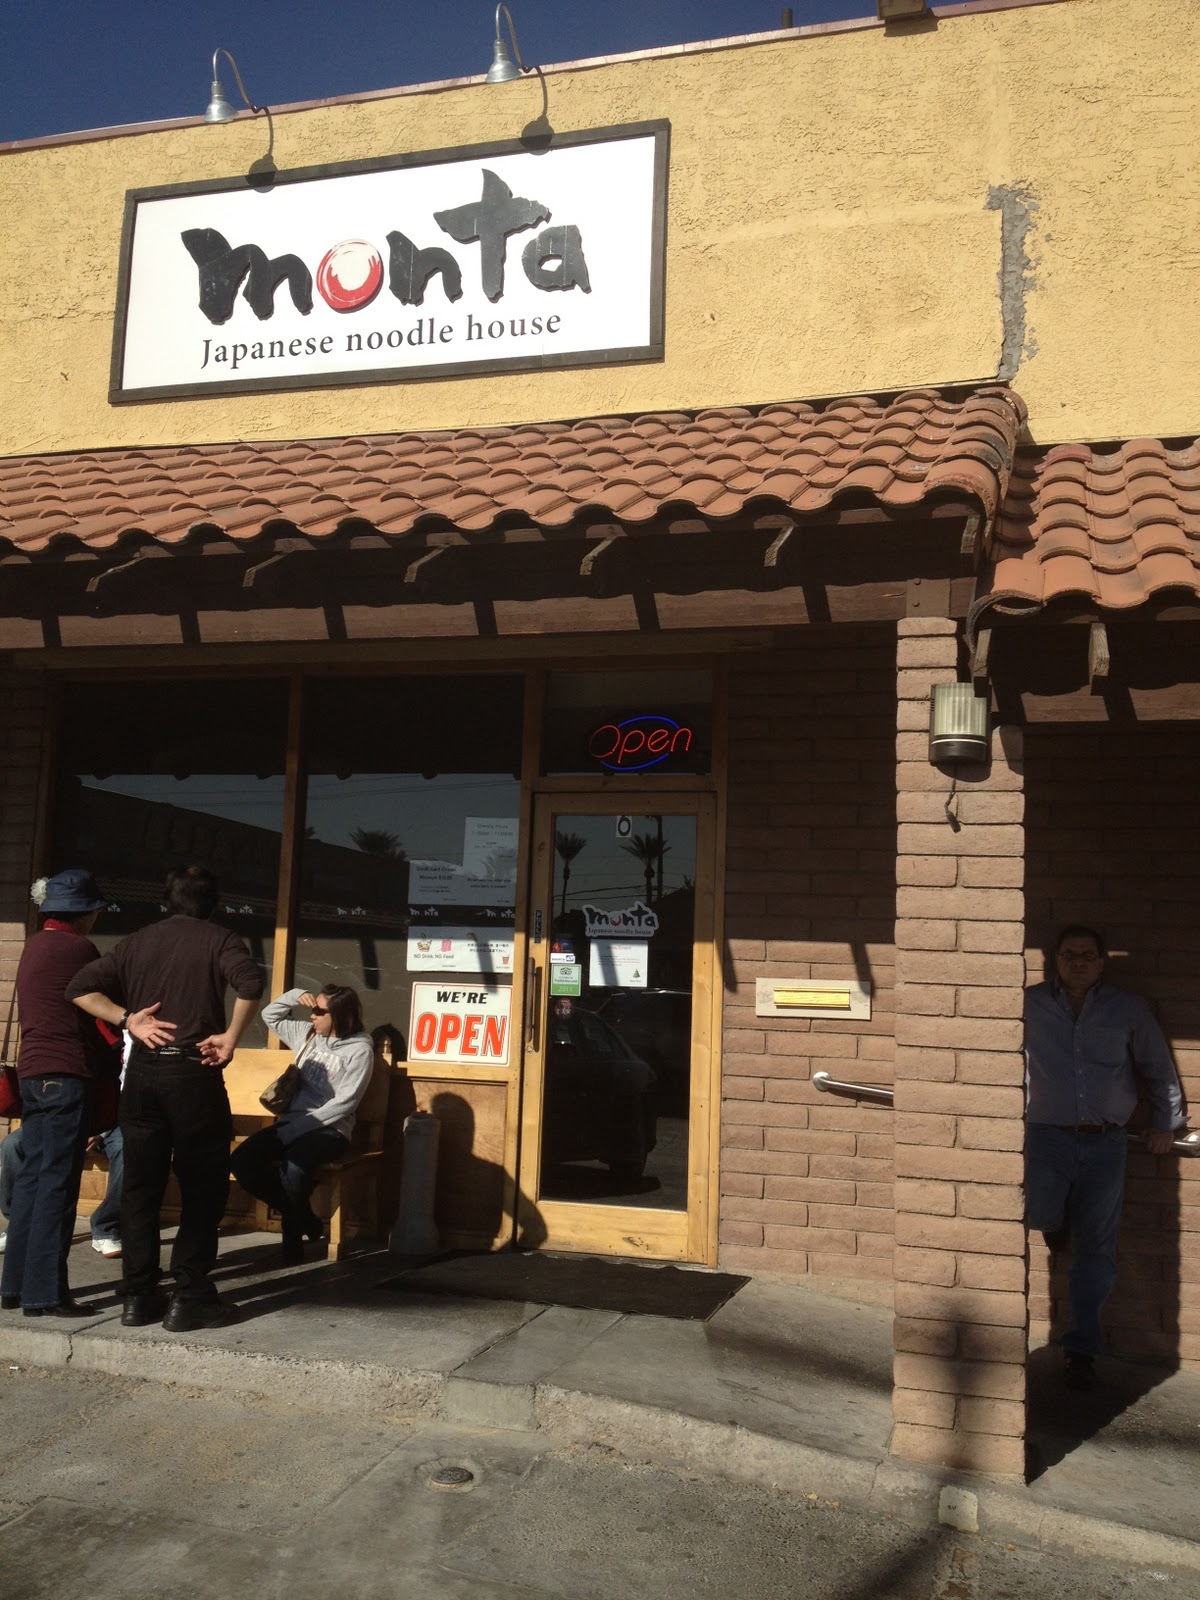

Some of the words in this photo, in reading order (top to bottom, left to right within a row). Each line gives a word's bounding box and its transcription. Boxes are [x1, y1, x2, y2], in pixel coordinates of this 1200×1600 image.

[181, 168, 591, 325] monta
[201, 333, 333, 370] Japanese
[346, 319, 453, 352] noodle
[466, 314, 562, 341] house
[589, 724, 692, 763] Open
[436, 990, 489, 1004] WE'RE
[414, 1011, 508, 1057] OPEN
